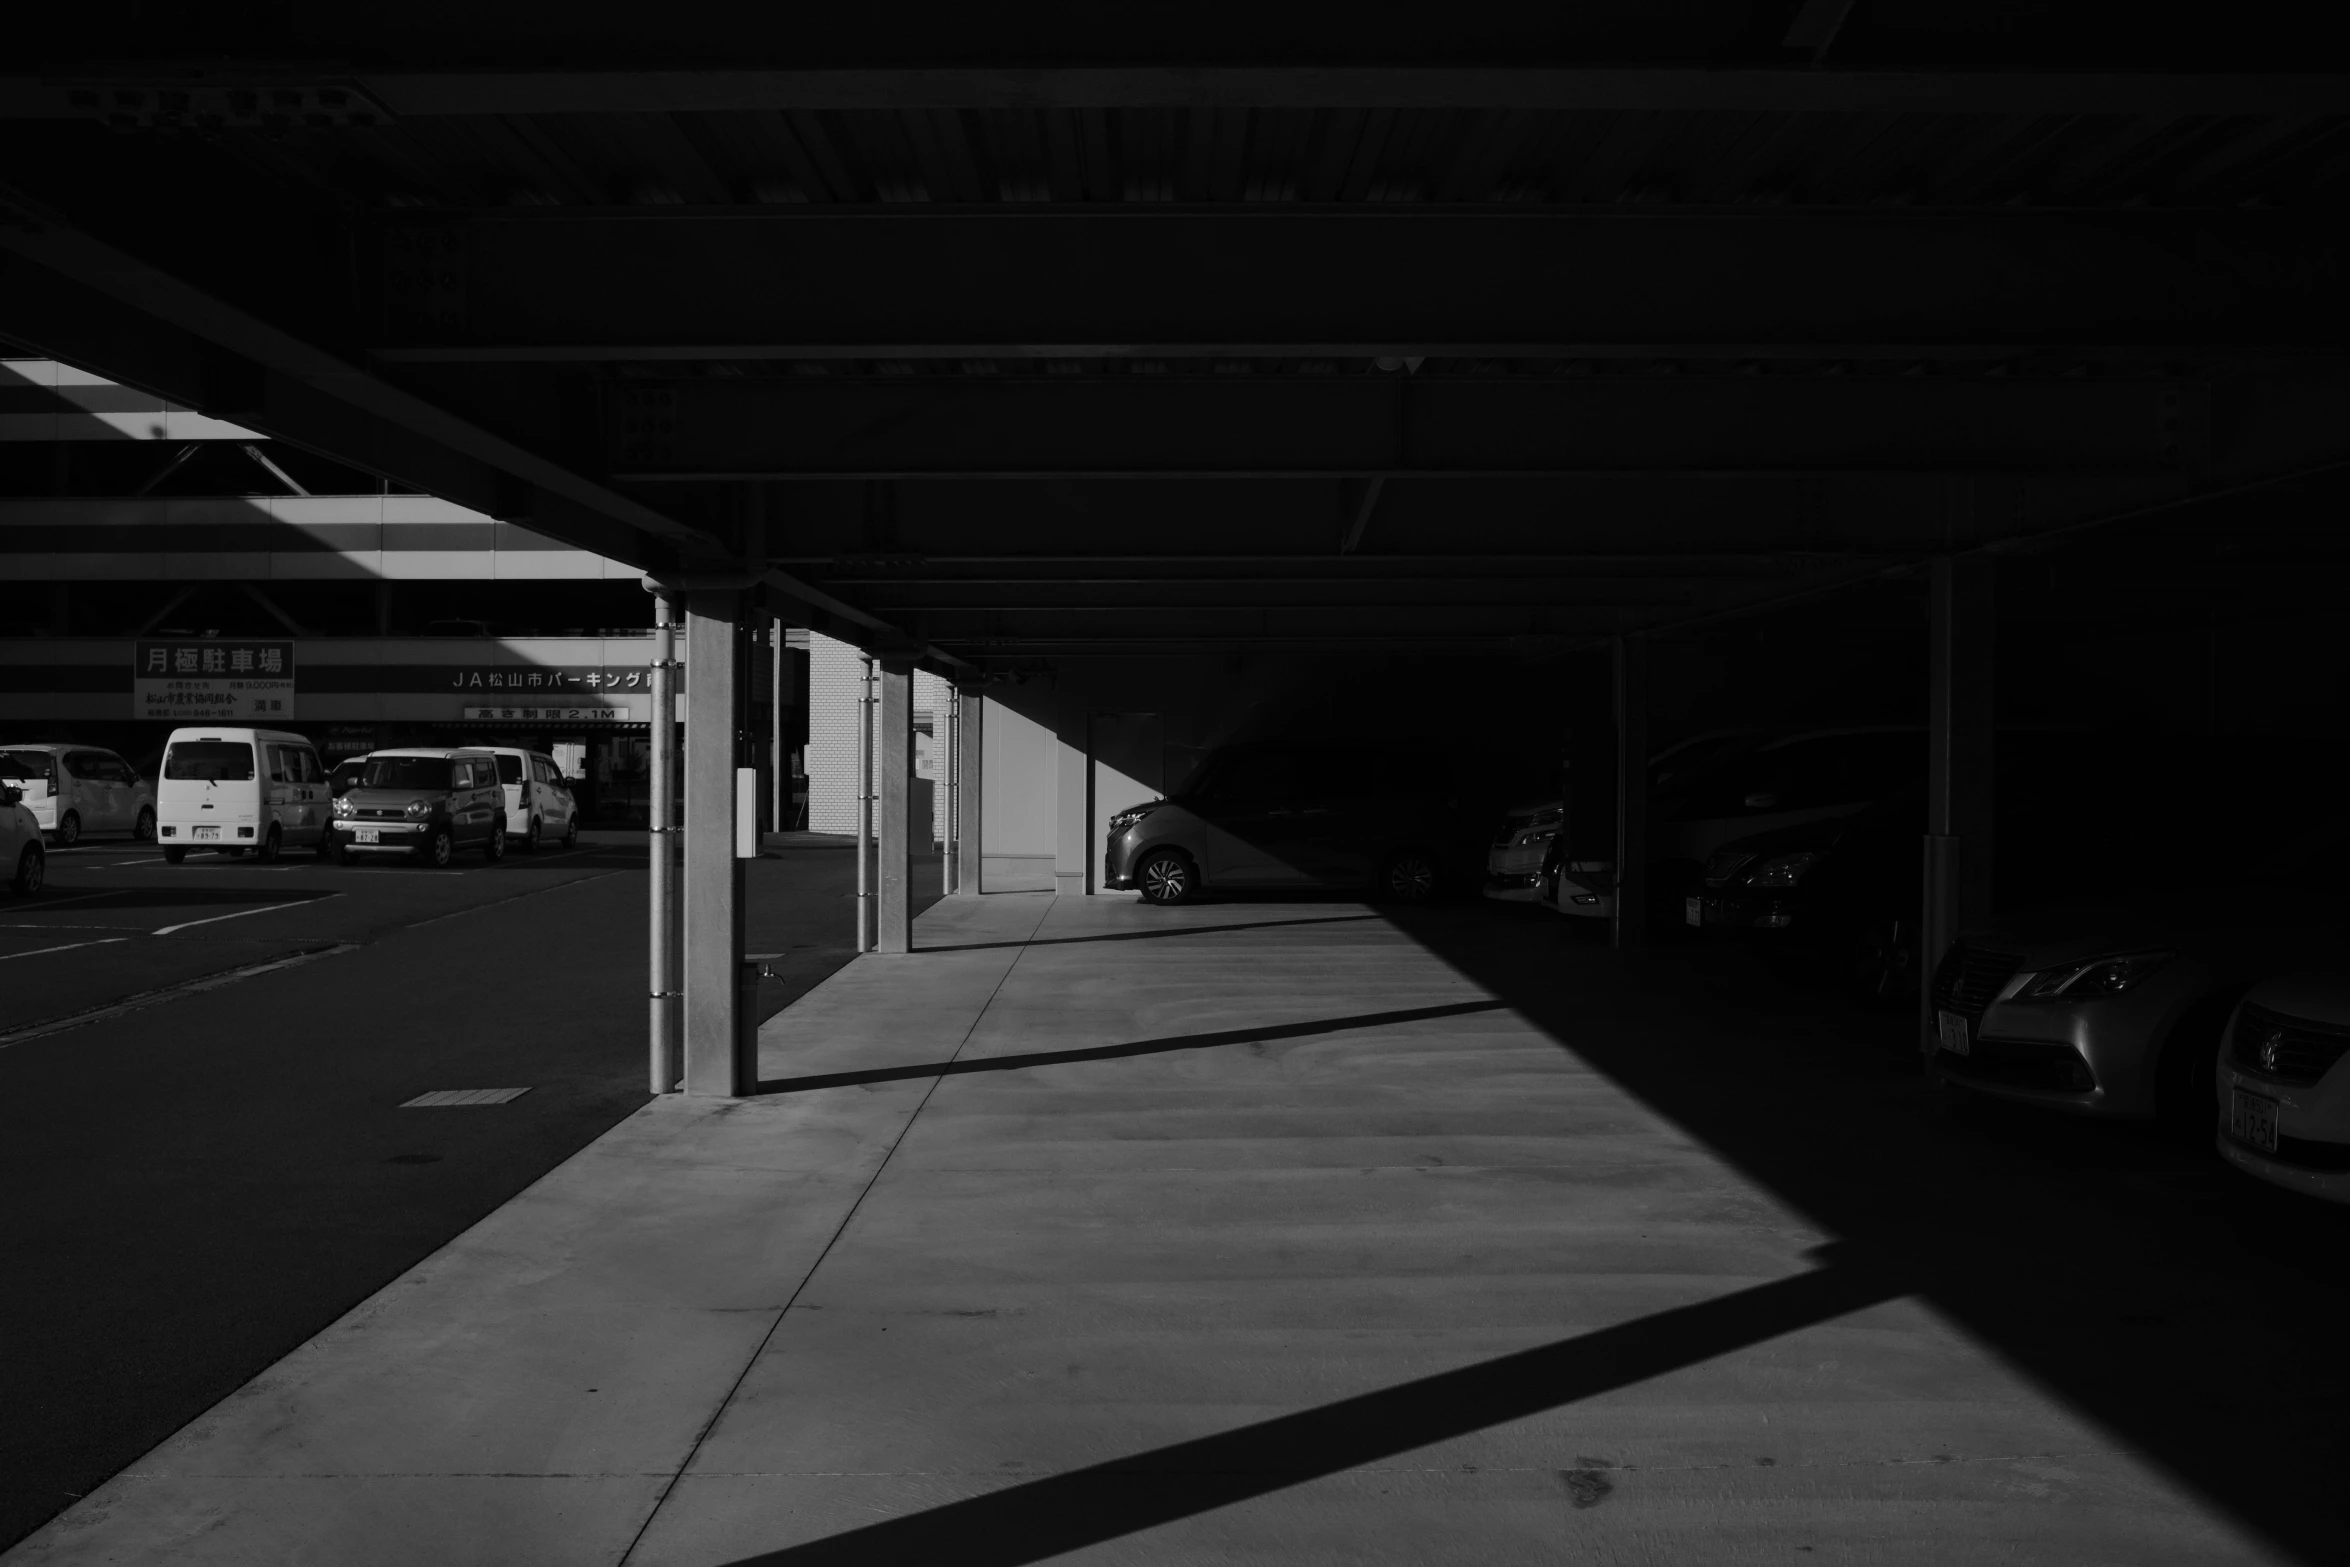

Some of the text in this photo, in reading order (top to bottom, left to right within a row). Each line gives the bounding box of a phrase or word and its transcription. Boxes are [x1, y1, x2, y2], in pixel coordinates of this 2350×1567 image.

[146, 648, 282, 673] 月極駐車場
[254, 700, 282, 712] 満車
